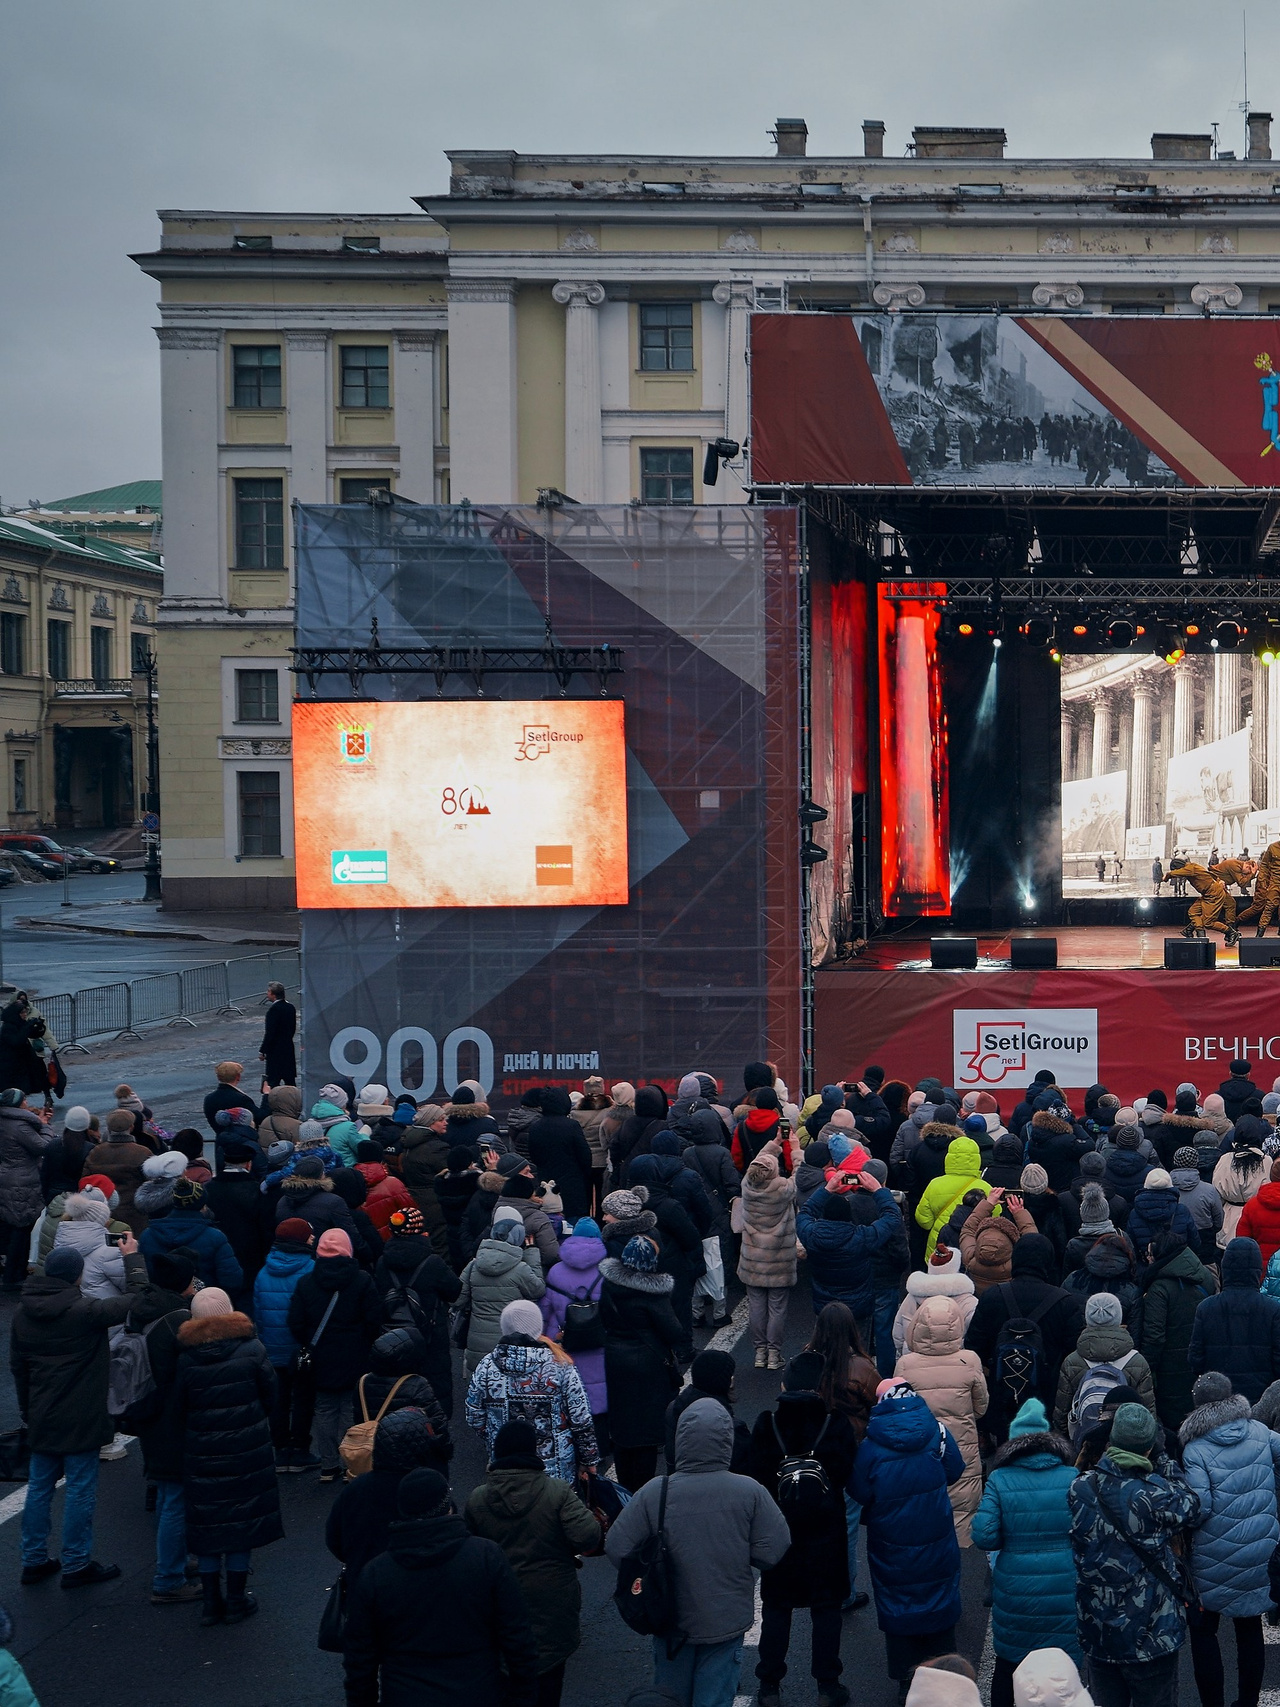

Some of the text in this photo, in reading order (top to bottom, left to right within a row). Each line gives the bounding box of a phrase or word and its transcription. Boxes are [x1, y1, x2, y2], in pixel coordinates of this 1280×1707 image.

[329, 1026, 494, 1103] 900
[503, 1051, 599, 1072] ДНЕЙ И НОЧЕЙ
[1001, 1057, 1018, 1065] лет
